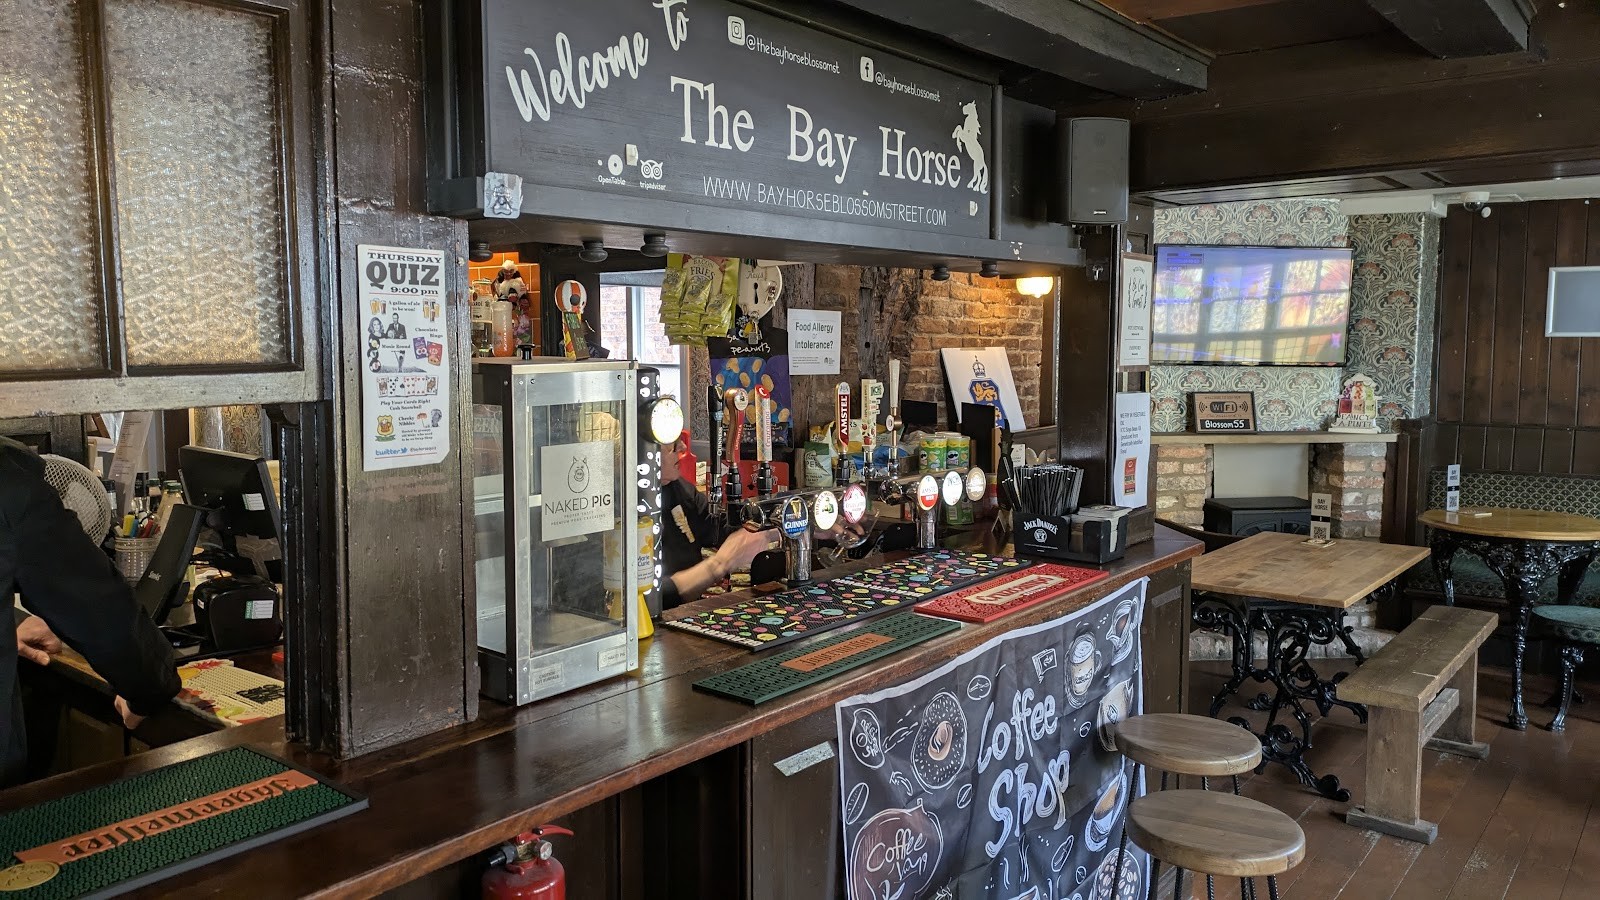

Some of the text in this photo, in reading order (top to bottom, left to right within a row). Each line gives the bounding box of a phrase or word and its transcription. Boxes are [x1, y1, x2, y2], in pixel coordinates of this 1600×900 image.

[506, 0, 689, 122] Welcome to
[745, 34, 840, 74] @thebayhorseblossomst
[875, 72, 940, 102] @bayhorseblossomst
[671, 75, 961, 188] The Bay Horse
[598, 174, 626, 186] OpenTable
[640, 181, 667, 191] tripadvisor
[367, 252, 442, 263] THURSDAY
[366, 260, 439, 290] QUIZ
[690, 266, 715, 280] FRIES
[795, 322, 834, 333] Food Allergy
[730, 342, 771, 355] peanuts
[795, 340, 834, 349] Intolerance?
[1205, 420, 1244, 429] Blossom55
[545, 494, 611, 515] NAKED PIG
[978, 688, 1058, 774] Coffee
[985, 750, 1070, 858] Shop
[866, 828, 927, 872] Coffee
